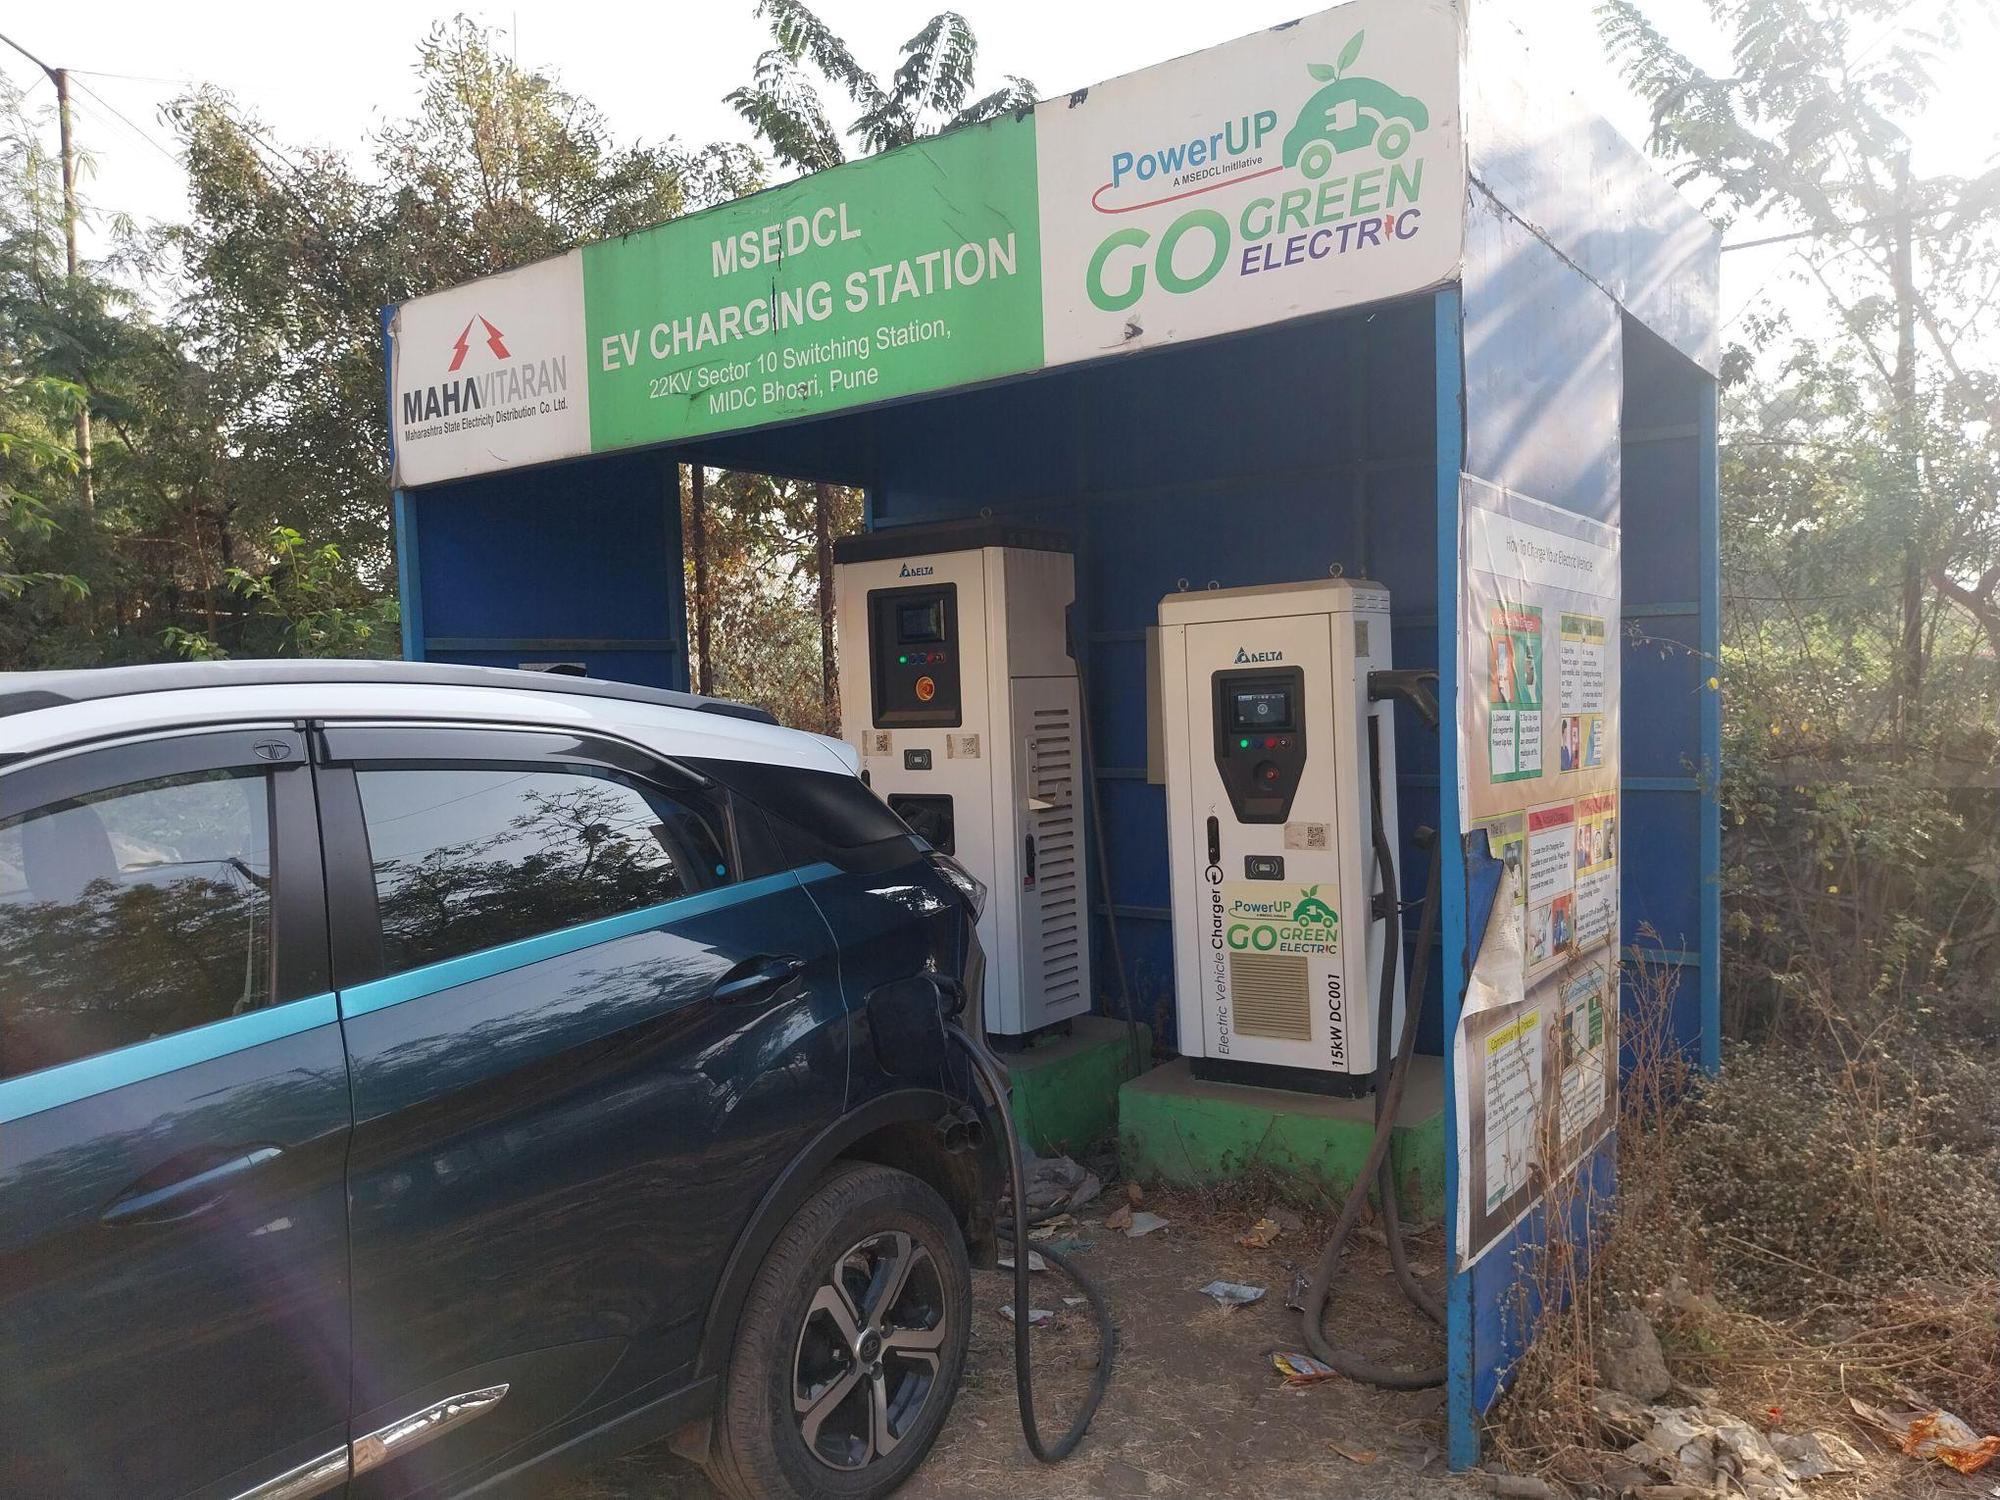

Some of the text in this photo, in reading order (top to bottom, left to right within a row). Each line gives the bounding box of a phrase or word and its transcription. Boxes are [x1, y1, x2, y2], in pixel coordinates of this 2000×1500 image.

[1111, 109, 1278, 189] PowerUP
[1173, 177, 1181, 187] A
[1181, 168, 1222, 185] MSEDCL
[1239, 158, 1424, 241] GREEN
[712, 203, 862, 278] MSEDCL
[1086, 208, 1232, 312] GO
[1240, 208, 1422, 276] ELECTRIC
[601, 232, 1018, 372] EV CHARGING STATION
[404, 355, 568, 424] MAHAVITARAN
[649, 317, 951, 399] 22KV Sector 10 Switching Station,
[709, 390, 756, 415] MIDC
[830, 368, 879, 393] Pune
[405, 397, 568, 441] Maharashtra State Electricity Distribution Co. Ltd.
[911, 566, 934, 577] DELTA
[1251, 651, 1283, 662] DELTA
[1227, 924, 1277, 951] GO
[1235, 900, 1291, 913] PowerUP
[1280, 927, 1338, 942] GREEN
[1212, 889, 1229, 1055] Electric Vehicle Charger
[1280, 942, 1337, 954] ELECTRIC
[1328, 974, 1344, 1066] 15kW DC001
